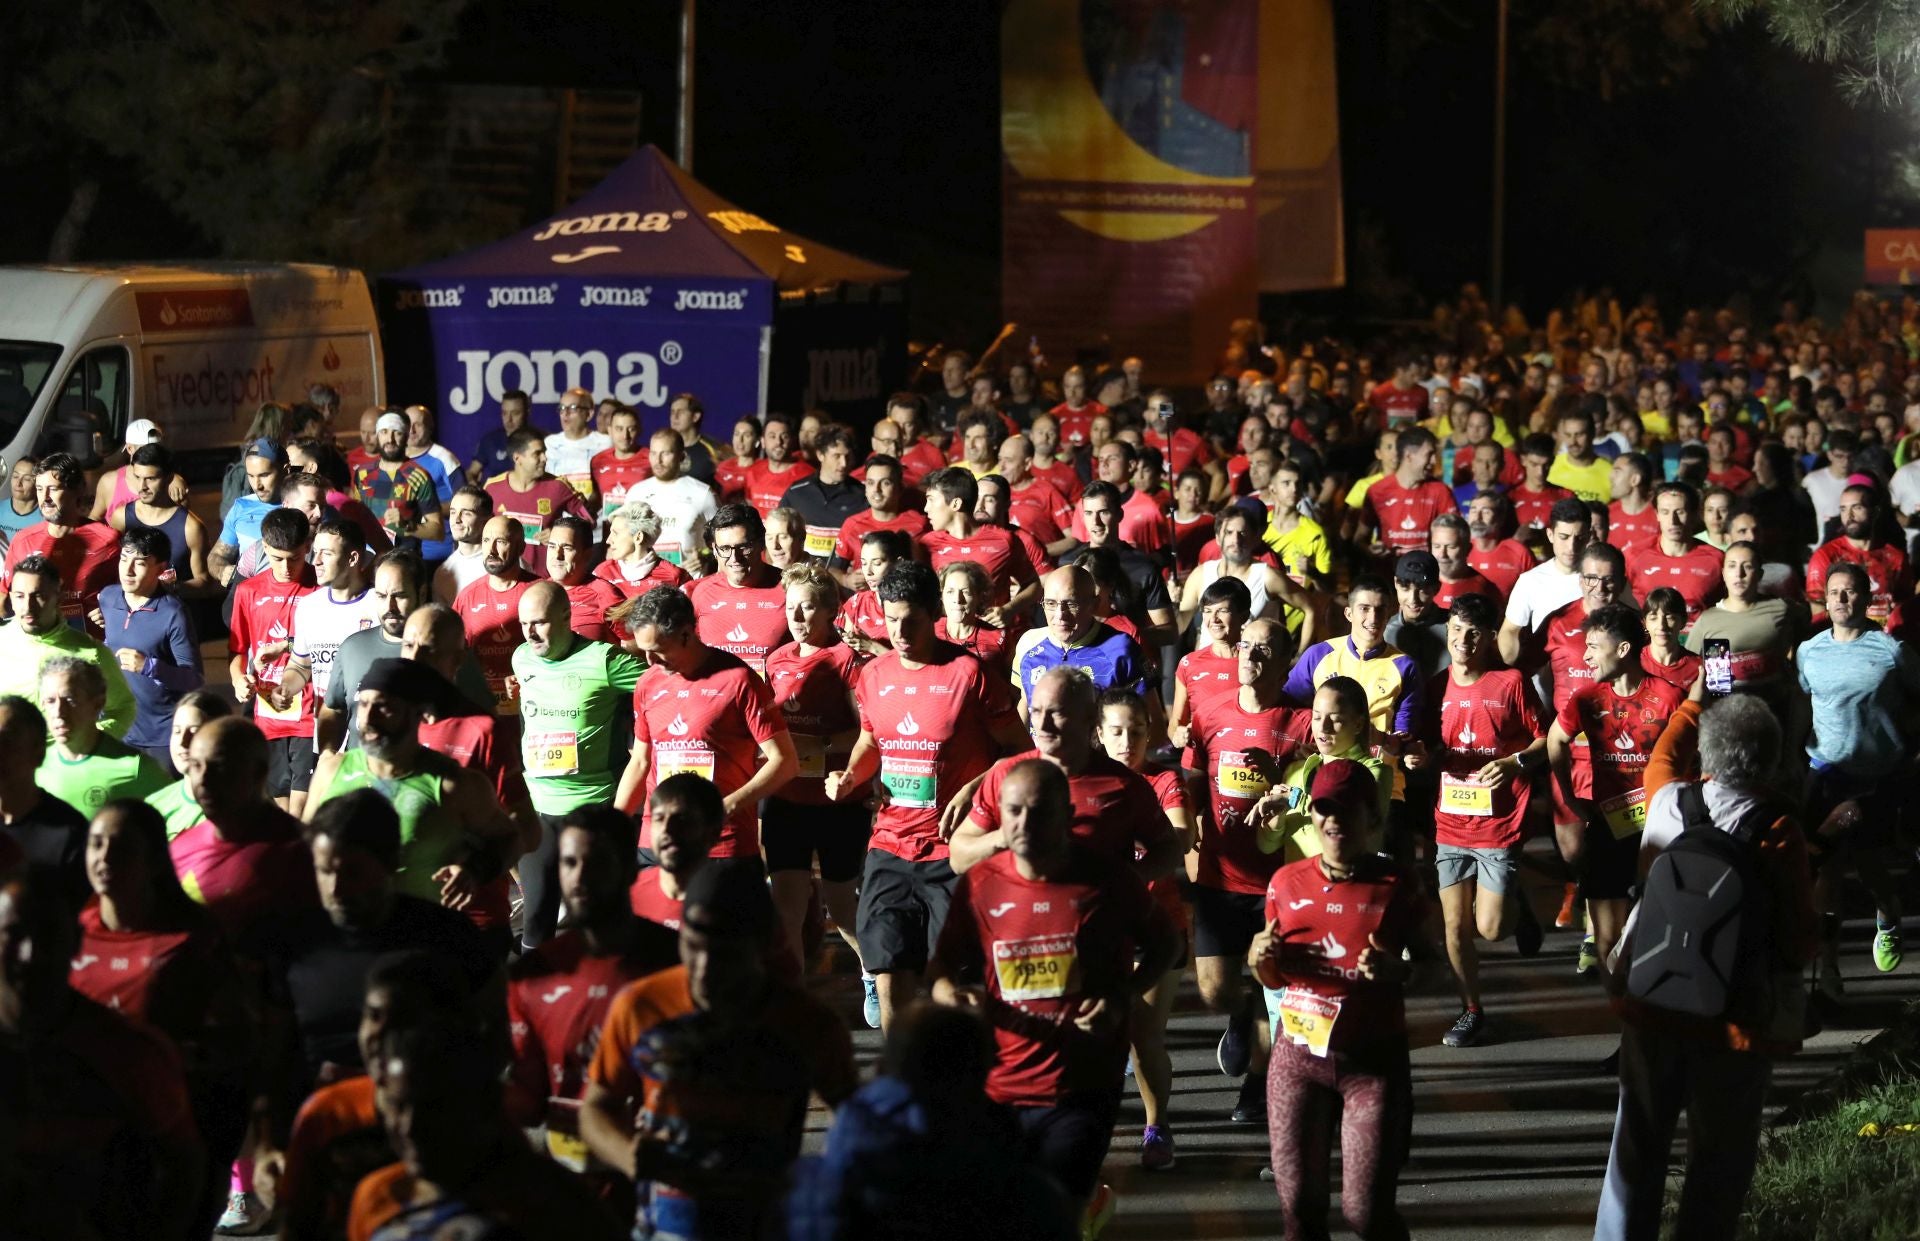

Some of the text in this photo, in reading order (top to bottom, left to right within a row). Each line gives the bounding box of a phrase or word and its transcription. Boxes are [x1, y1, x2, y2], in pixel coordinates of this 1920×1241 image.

[177, 303, 232, 323] Santander
[879, 737, 942, 751] Santander
[891, 762, 933, 774] Santander
[1231, 770, 1264, 783] 1942
[890, 777, 921, 790] 3075
[1452, 789, 1478, 800] 2251
[1012, 940, 1073, 956] Santander
[1015, 960, 1059, 977] 1950
